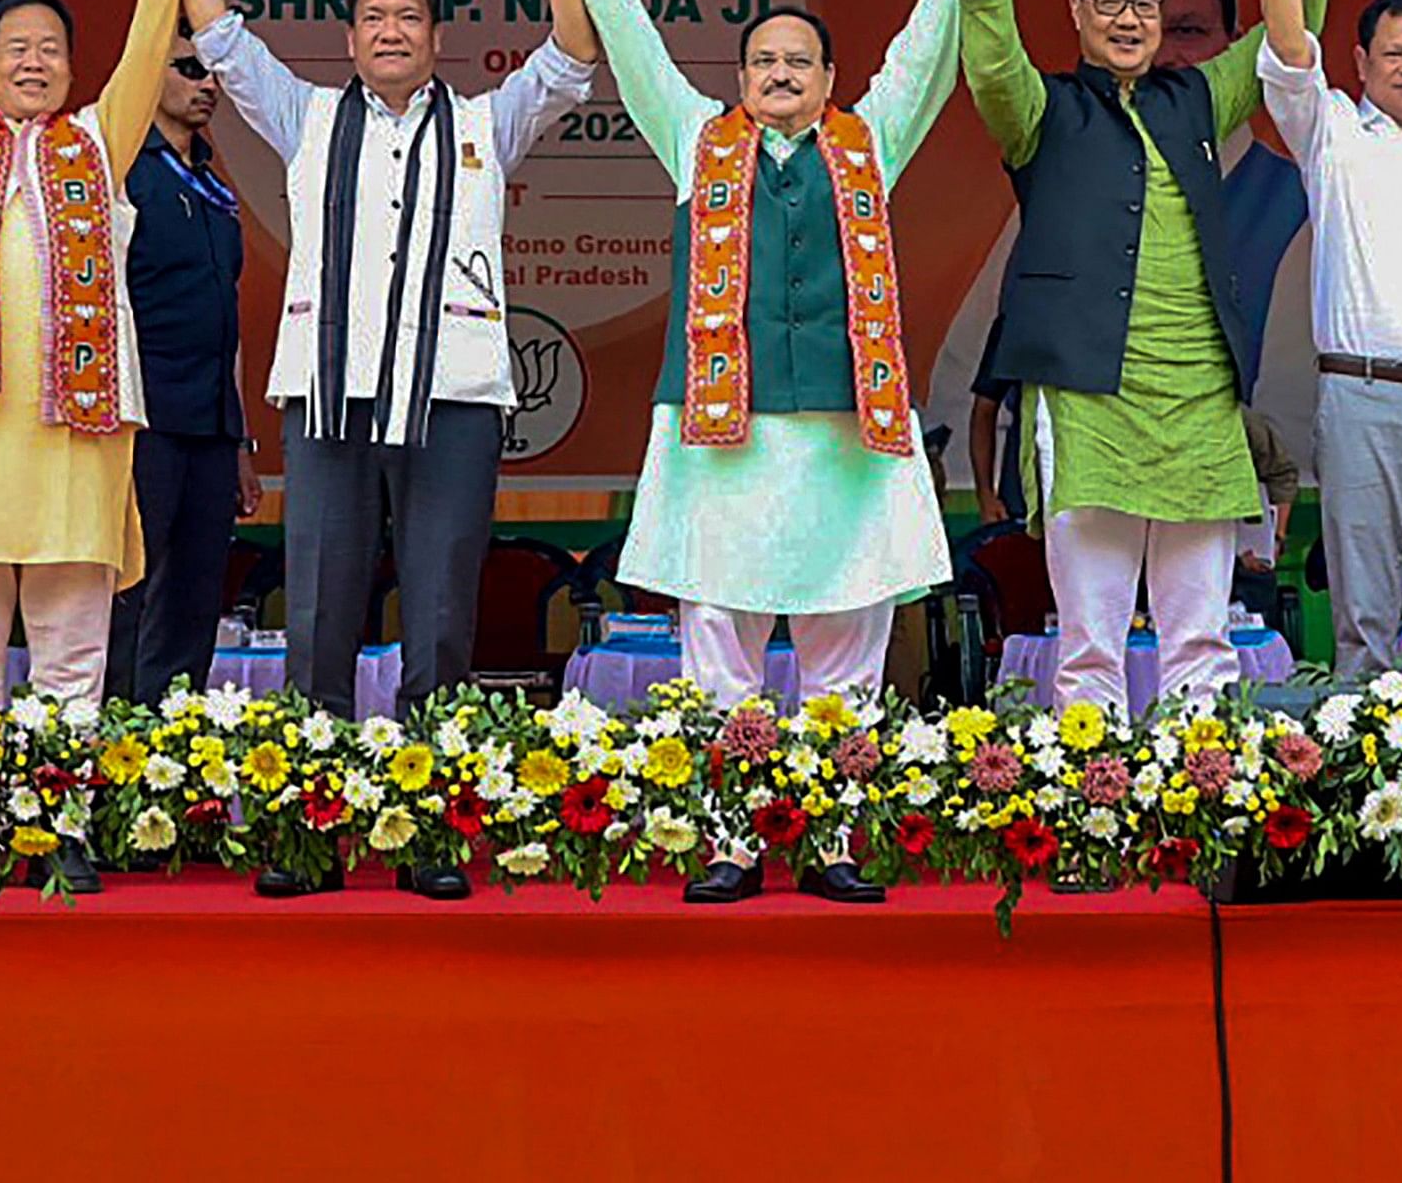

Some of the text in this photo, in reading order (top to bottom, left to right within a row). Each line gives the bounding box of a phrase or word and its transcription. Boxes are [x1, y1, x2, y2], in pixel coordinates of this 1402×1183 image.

[558, 112, 643, 142] 202
[64, 181, 95, 373] BJP
[536, 265, 649, 285] Pradesh
[707, 183, 732, 385] BJP
[854, 191, 892, 389] BJP
